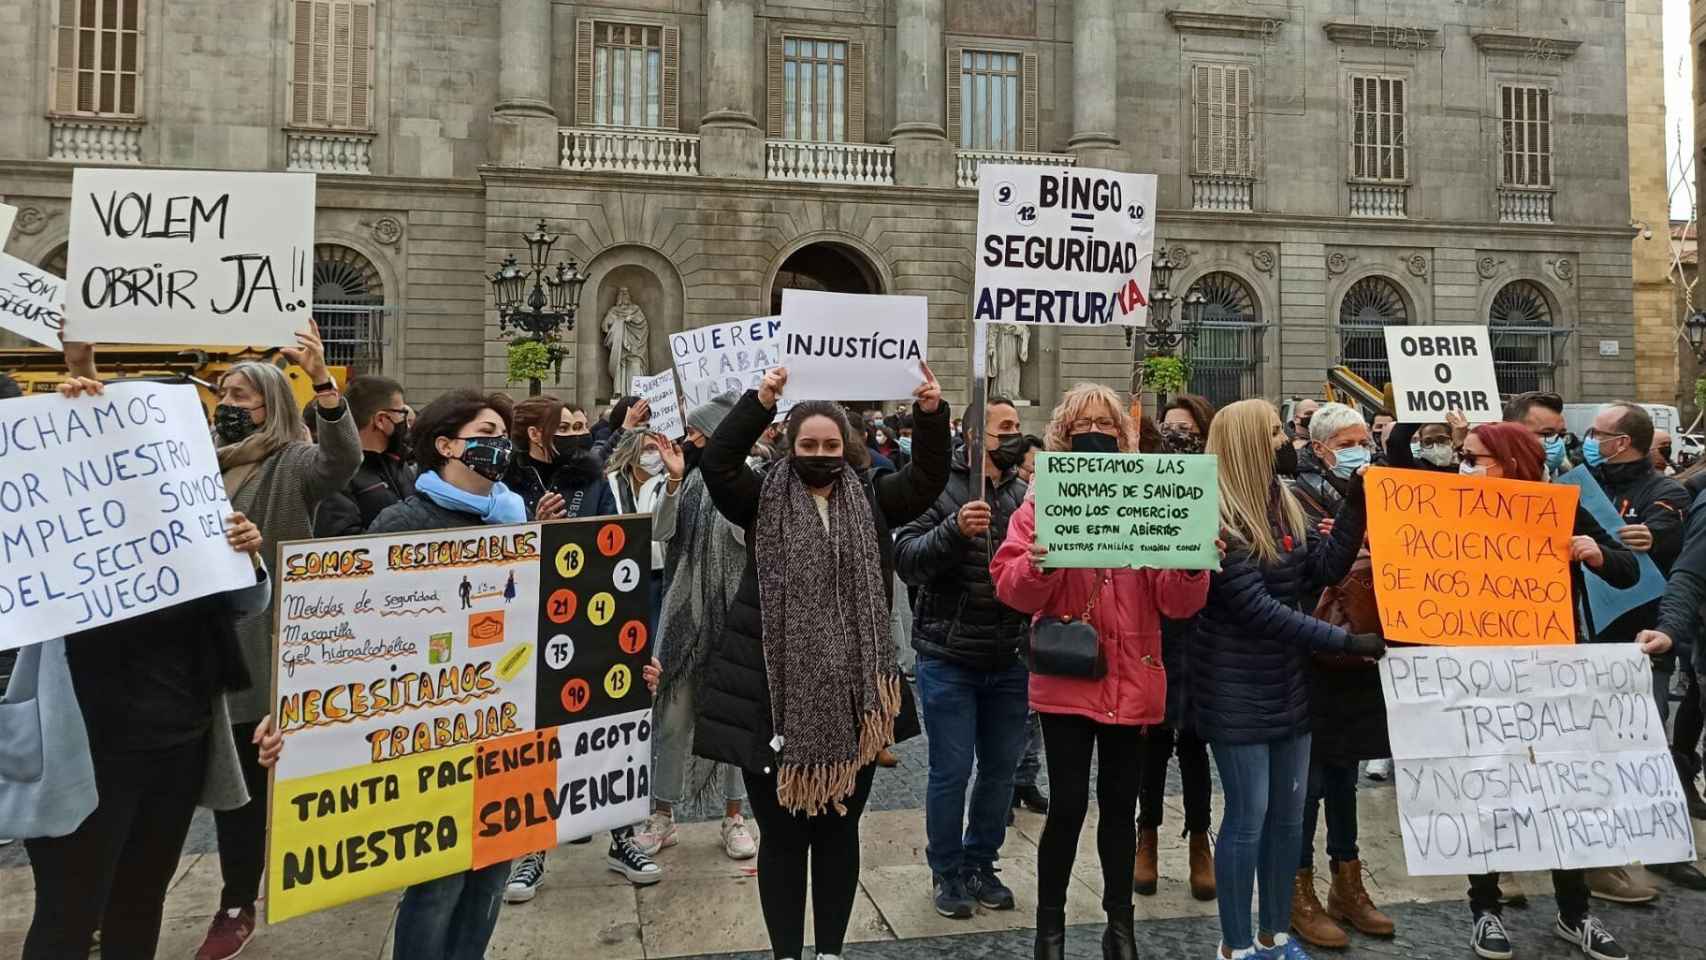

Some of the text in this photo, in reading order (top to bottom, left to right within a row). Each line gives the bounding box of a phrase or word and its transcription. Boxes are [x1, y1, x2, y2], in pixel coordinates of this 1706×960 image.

[998, 185, 1012, 202] 9
[90, 190, 229, 242] VOLEM
[1017, 206, 1036, 221] 12
[1127, 205, 1144, 219] 20
[13, 271, 59, 302] SOM
[211, 245, 306, 315] JA!!
[974, 279, 1148, 324] APERTURA YA
[786, 332, 922, 360] INJUSTÍCIA
[1400, 336, 1479, 356] OBRIR
[1434, 363, 1451, 384] O
[1407, 390, 1489, 412] MORIR
[62, 439, 191, 497] NUESTRO
[1048, 456, 1185, 475] RESPETAMOS LAS
[1058, 482, 1118, 499] NORMAS
[1122, 485, 1138, 498] DE
[1377, 477, 1560, 529] POR TANTA
[2, 471, 229, 564] MPLEO SOMOS
[1045, 505, 1082, 518] COMO
[1086, 504, 1110, 518] LOS
[606, 531, 615, 551] 1
[1054, 524, 1080, 536] QUE
[1086, 524, 1120, 536] ESTAN
[1396, 523, 1567, 564] PACIENCIA
[73, 519, 193, 585] SECTOR
[199, 509, 229, 540] DEL
[286, 531, 538, 577] SOMOS RESPONSABLES
[1049, 542, 1094, 552] NUESTRAS
[563, 551, 579, 571] 18
[621, 566, 632, 584] 2
[1382, 563, 1567, 604] SE NOS ACABÓ
[66, 565, 180, 625] JUEGO
[285, 593, 345, 616] Medidas
[355, 589, 372, 609] de
[553, 597, 568, 616] 21
[595, 600, 606, 620] 4
[1385, 599, 1571, 642] LA SOLVENCIA
[283, 622, 354, 642] Mascarilla
[627, 624, 638, 650] 9
[282, 646, 311, 677] Gel
[551, 643, 569, 664] 75
[611, 670, 626, 690] 13
[280, 661, 493, 729] NECESITAMOS
[568, 687, 585, 707] 90
[365, 701, 519, 763] TRABAJAR
[291, 773, 400, 822] TANTA
[575, 711, 652, 758] AGOTÓ
[1401, 766, 1425, 800] Y
[1404, 807, 1543, 861] VOLEM
[282, 815, 458, 891] NUESTRA
